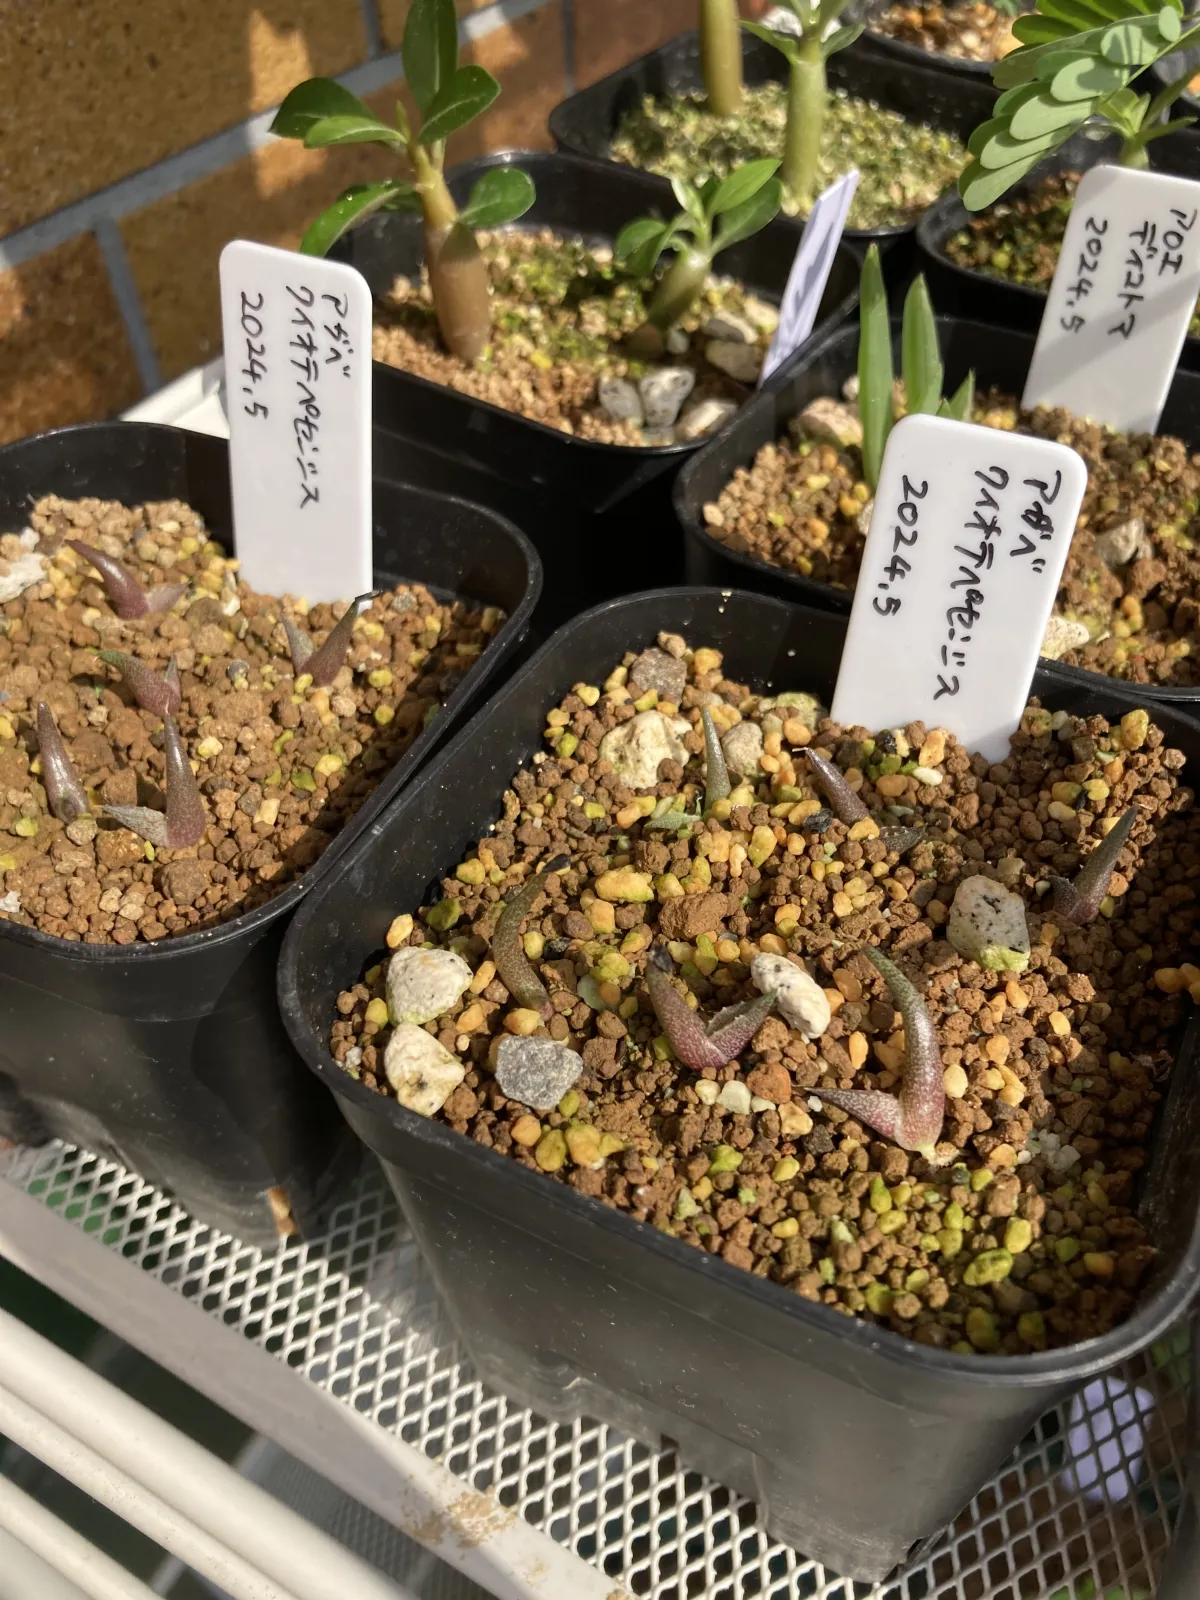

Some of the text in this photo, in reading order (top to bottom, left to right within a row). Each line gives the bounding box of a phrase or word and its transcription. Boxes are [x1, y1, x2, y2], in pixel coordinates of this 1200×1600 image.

[1060, 217, 1108, 334] 2024.5
[1158, 208, 1198, 276] アロエ
[321, 292, 354, 378] アガベ
[1010, 469, 1062, 573] アガベ
